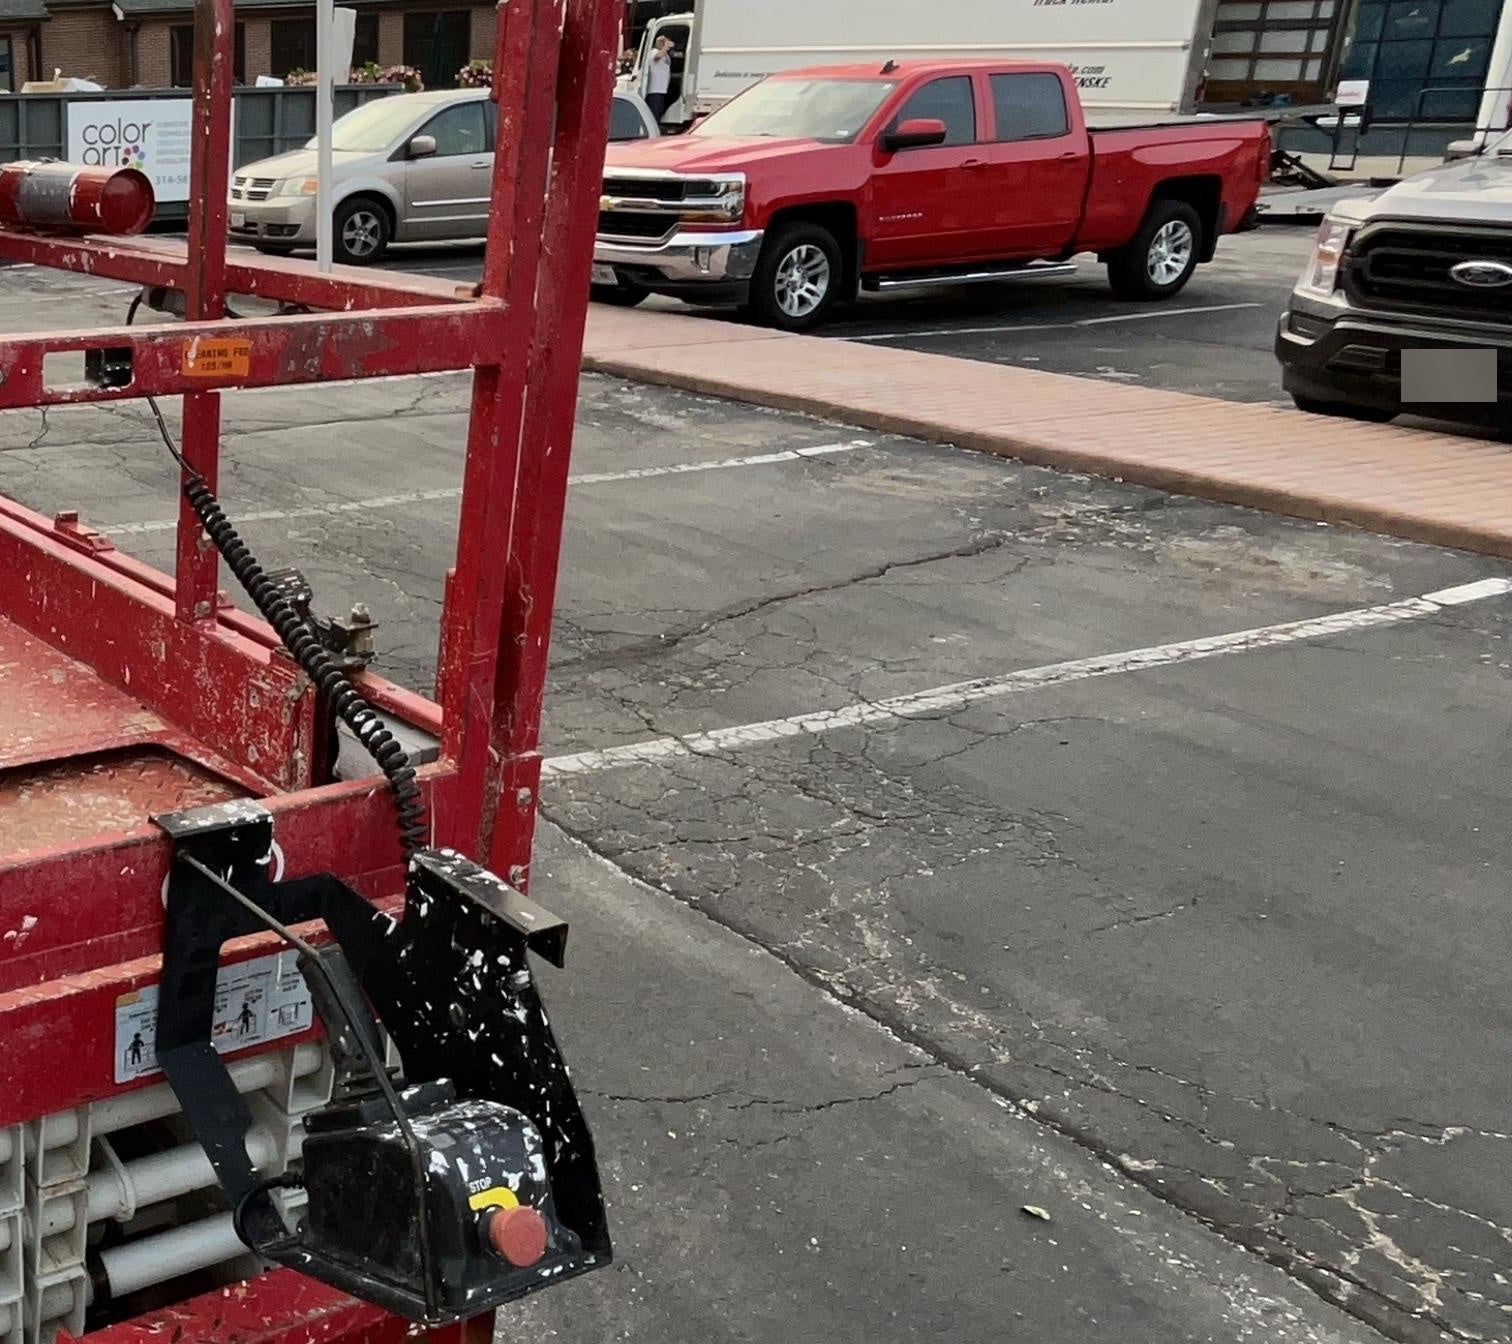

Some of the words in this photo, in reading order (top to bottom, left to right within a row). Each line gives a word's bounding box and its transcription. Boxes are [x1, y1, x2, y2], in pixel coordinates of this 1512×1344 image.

[1073, 76, 1112, 89] ENSKE
[82, 117, 152, 146] color
[82, 145, 122, 167] art
[468, 1176, 493, 1194] STOP
